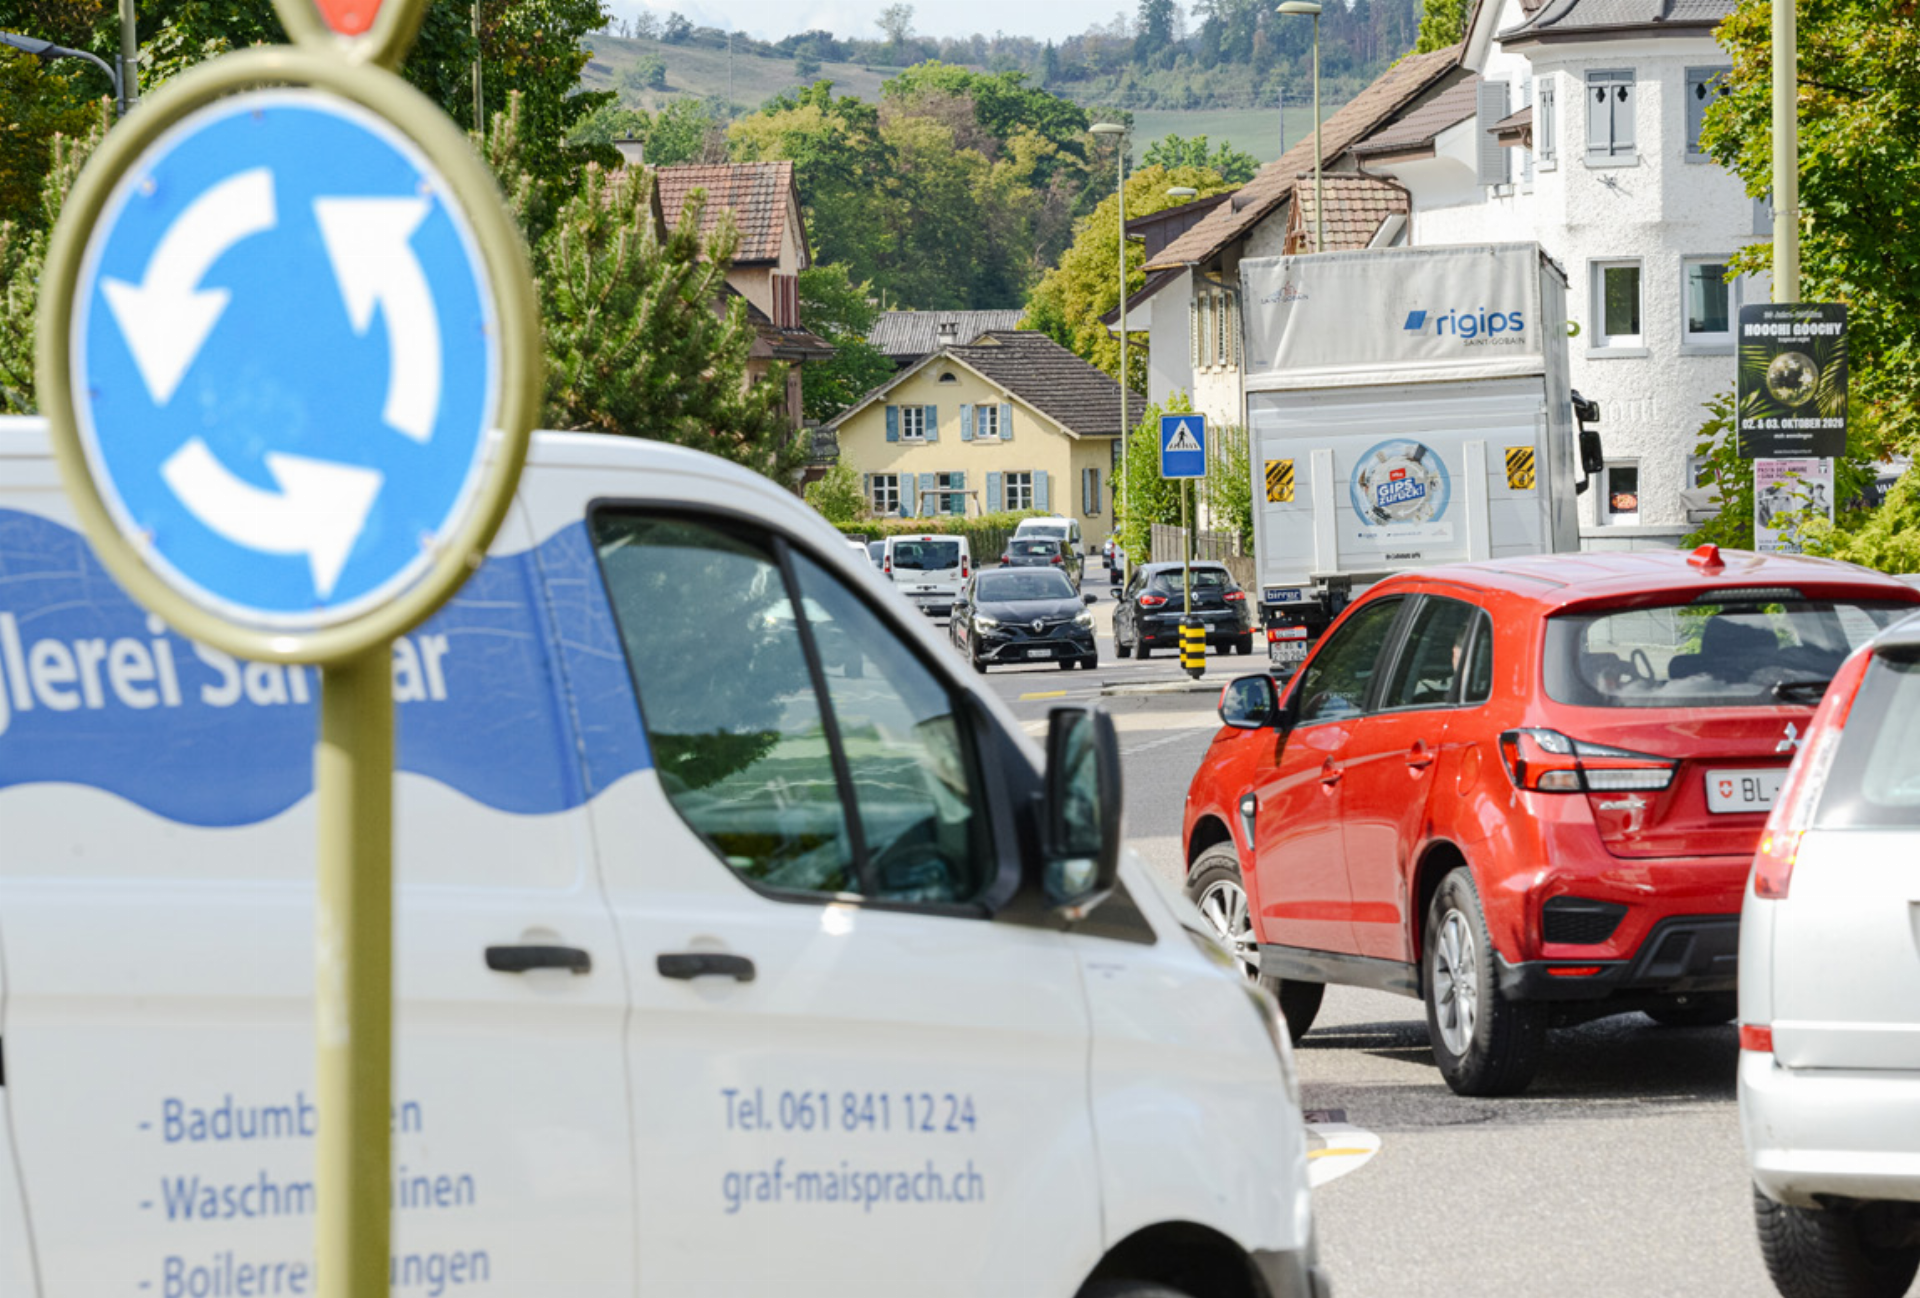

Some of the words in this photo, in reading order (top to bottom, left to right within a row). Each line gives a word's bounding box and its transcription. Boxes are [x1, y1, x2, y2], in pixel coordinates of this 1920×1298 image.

[1436, 306, 1525, 339] rigips
[1744, 323, 1791, 337] HOOCHI
[1793, 322, 1842, 336] GOOCHY
[1781, 417, 1821, 429] OKTOBER
[1379, 479, 1413, 496] GIPS
[1267, 590, 1300, 599] birrer
[0, 611, 182, 736] lerei
[721, 1087, 772, 1131] Tel.
[778, 1090, 829, 1131] 061
[840, 1091, 890, 1132] 841
[722, 1157, 985, 1214] graf-maisprach.ch
